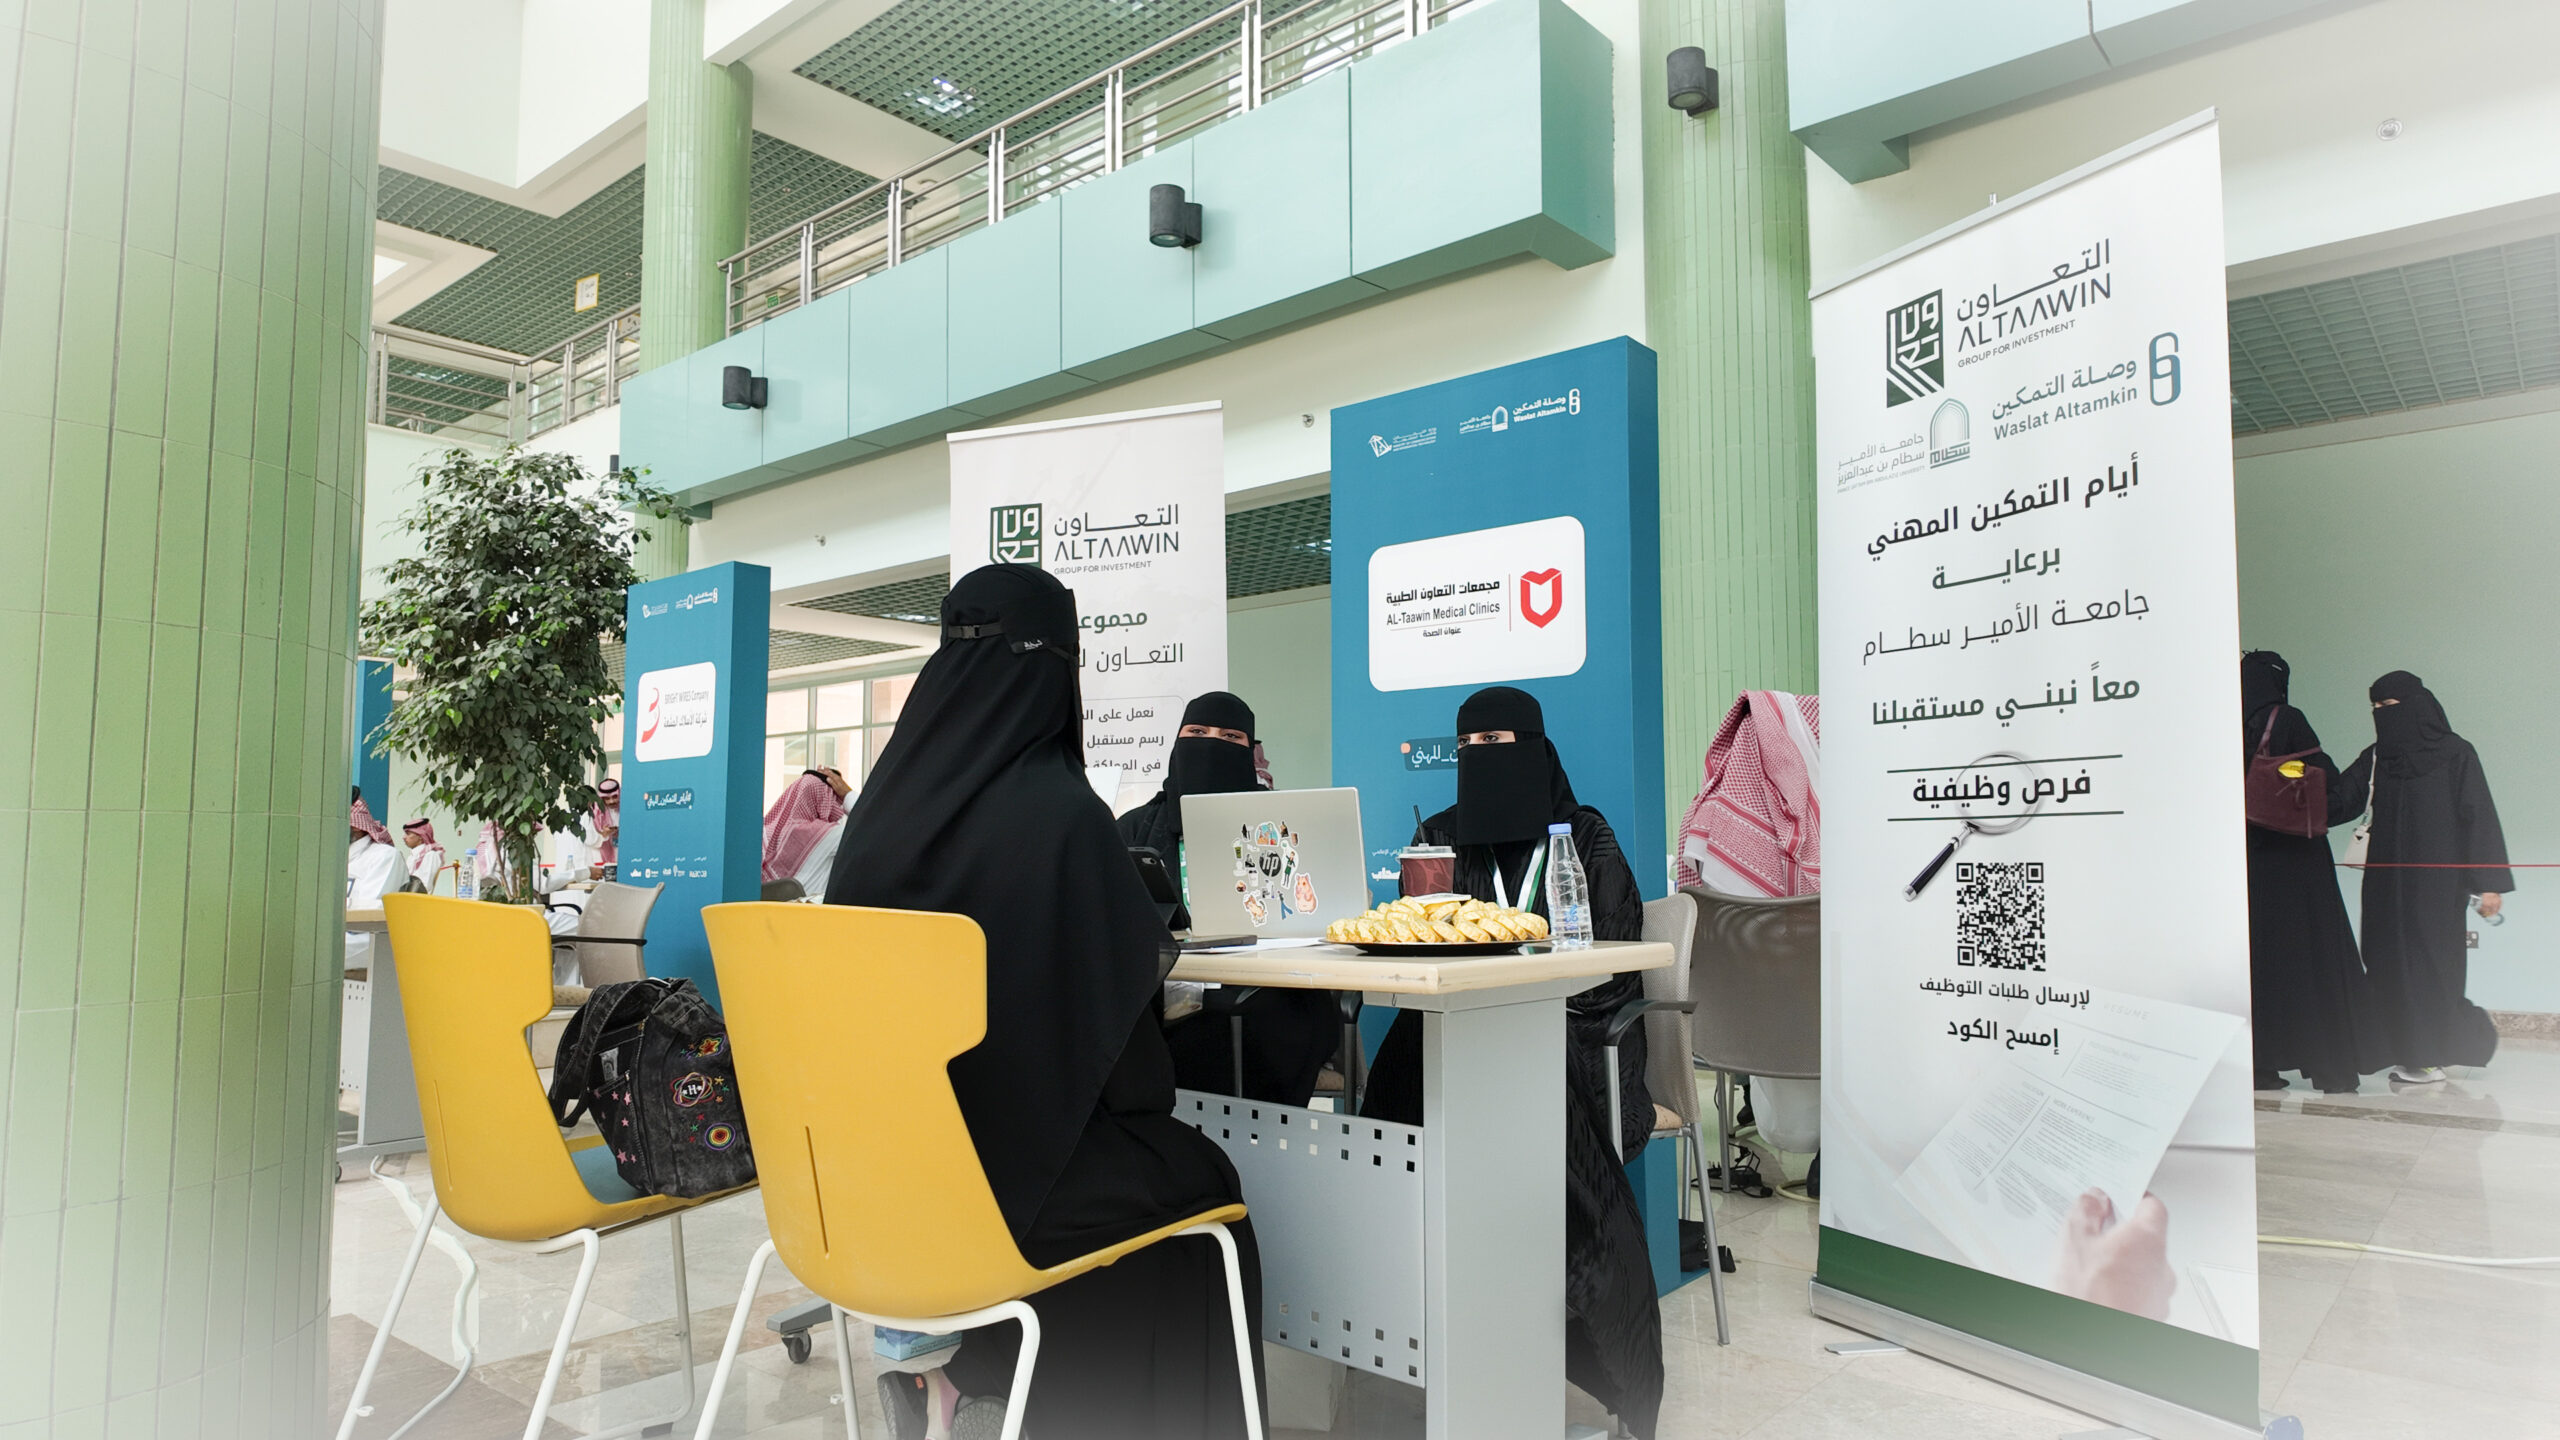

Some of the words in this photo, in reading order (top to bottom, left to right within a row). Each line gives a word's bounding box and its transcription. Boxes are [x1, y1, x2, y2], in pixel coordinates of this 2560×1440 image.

[1956, 238, 2111, 322] التعاون
[1957, 272, 2112, 353] ALTAAWIN
[1957, 347, 1990, 368] GROUP
[1992, 341, 2010, 357] FOR
[2011, 319, 2076, 351] INVESTMENT
[2071, 358, 2137, 389] وصلة
[1513, 400, 1542, 416] التمكين
[1536, 405, 1567, 418] Altamkin
[1992, 375, 2066, 420] التمكين
[1994, 410, 2049, 441] Waslat
[2054, 386, 2138, 423] Altamkin
[2084, 451, 2139, 508] أيام
[1970, 476, 2070, 532] التمكين
[1054, 503, 1179, 537] التعاون
[1867, 505, 1959, 562] المهني
[1053, 531, 1179, 562] ALTAAWIN
[1054, 565, 1082, 575] GROUP
[1083, 564, 1100, 573] FOR
[1101, 560, 1153, 572] INVESTMENT
[1931, 547, 2061, 590] برعاية
[1386, 589, 1418, 607] الطبية
[1420, 584, 1456, 602] التعاون
[1459, 580, 1500, 595] مجمعات
[1386, 609, 1431, 626] AL-Taawin
[1433, 604, 1467, 620] Medical
[1469, 600, 1501, 616] Clinics
[2051, 588, 2150, 626] جامعة
[1078, 612, 1148, 634] مجموع
[1423, 628, 1443, 638] الصحة
[1444, 626, 1462, 636] عنوان
[1960, 602, 2039, 650] الأمير
[1096, 642, 1183, 673] التعاون
[1863, 626, 1951, 666] سطام
[2090, 661, 2140, 702] معاً
[1098, 708, 1122, 723] على
[1126, 706, 1154, 722] نعمل
[1872, 696, 1985, 730] مستقبلنا
[1995, 679, 2078, 728] نبني
[1086, 734, 1135, 749] مستقبل
[1138, 735, 1164, 748] رسم
[1142, 758, 1161, 776] في
[1912, 774, 2010, 809] وظيفية
[2022, 768, 2091, 805] فرص
[1261, 851, 1281, 878] hp
[1919, 977, 1982, 997] التوظيف
[1988, 983, 2029, 1002] طلبات
[2035, 986, 2090, 1011] لإرسال
[1947, 1018, 1998, 1042] الكود
[2005, 1027, 2060, 1055] إمسح
